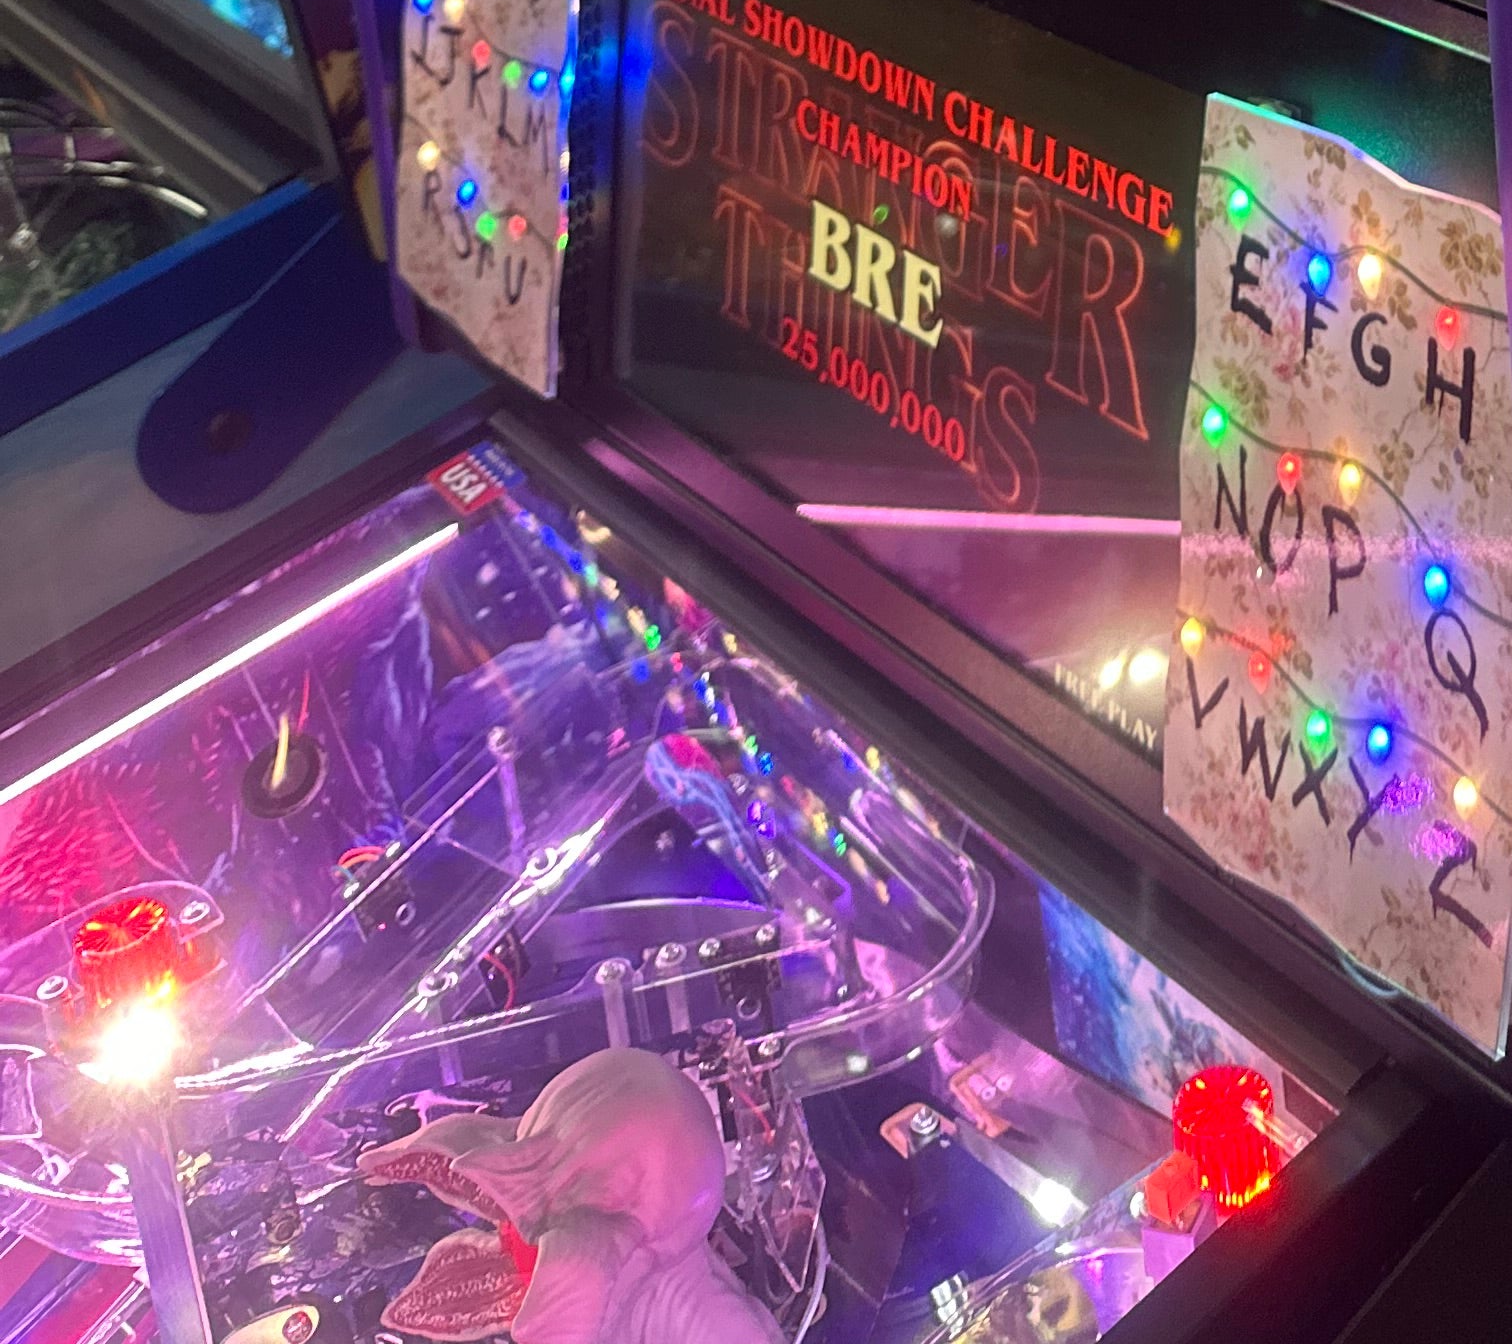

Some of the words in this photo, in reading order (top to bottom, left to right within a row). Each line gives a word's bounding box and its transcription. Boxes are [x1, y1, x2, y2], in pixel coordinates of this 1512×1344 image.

[795, 98, 974, 223] CHAMPION
[942, 89, 1176, 238] CHALLENGE
[808, 198, 946, 350] BRE
[780, 316, 967, 463] 25,000,000
[441, 461, 489, 504] USA
[1107, 698, 1158, 751] PLAY
